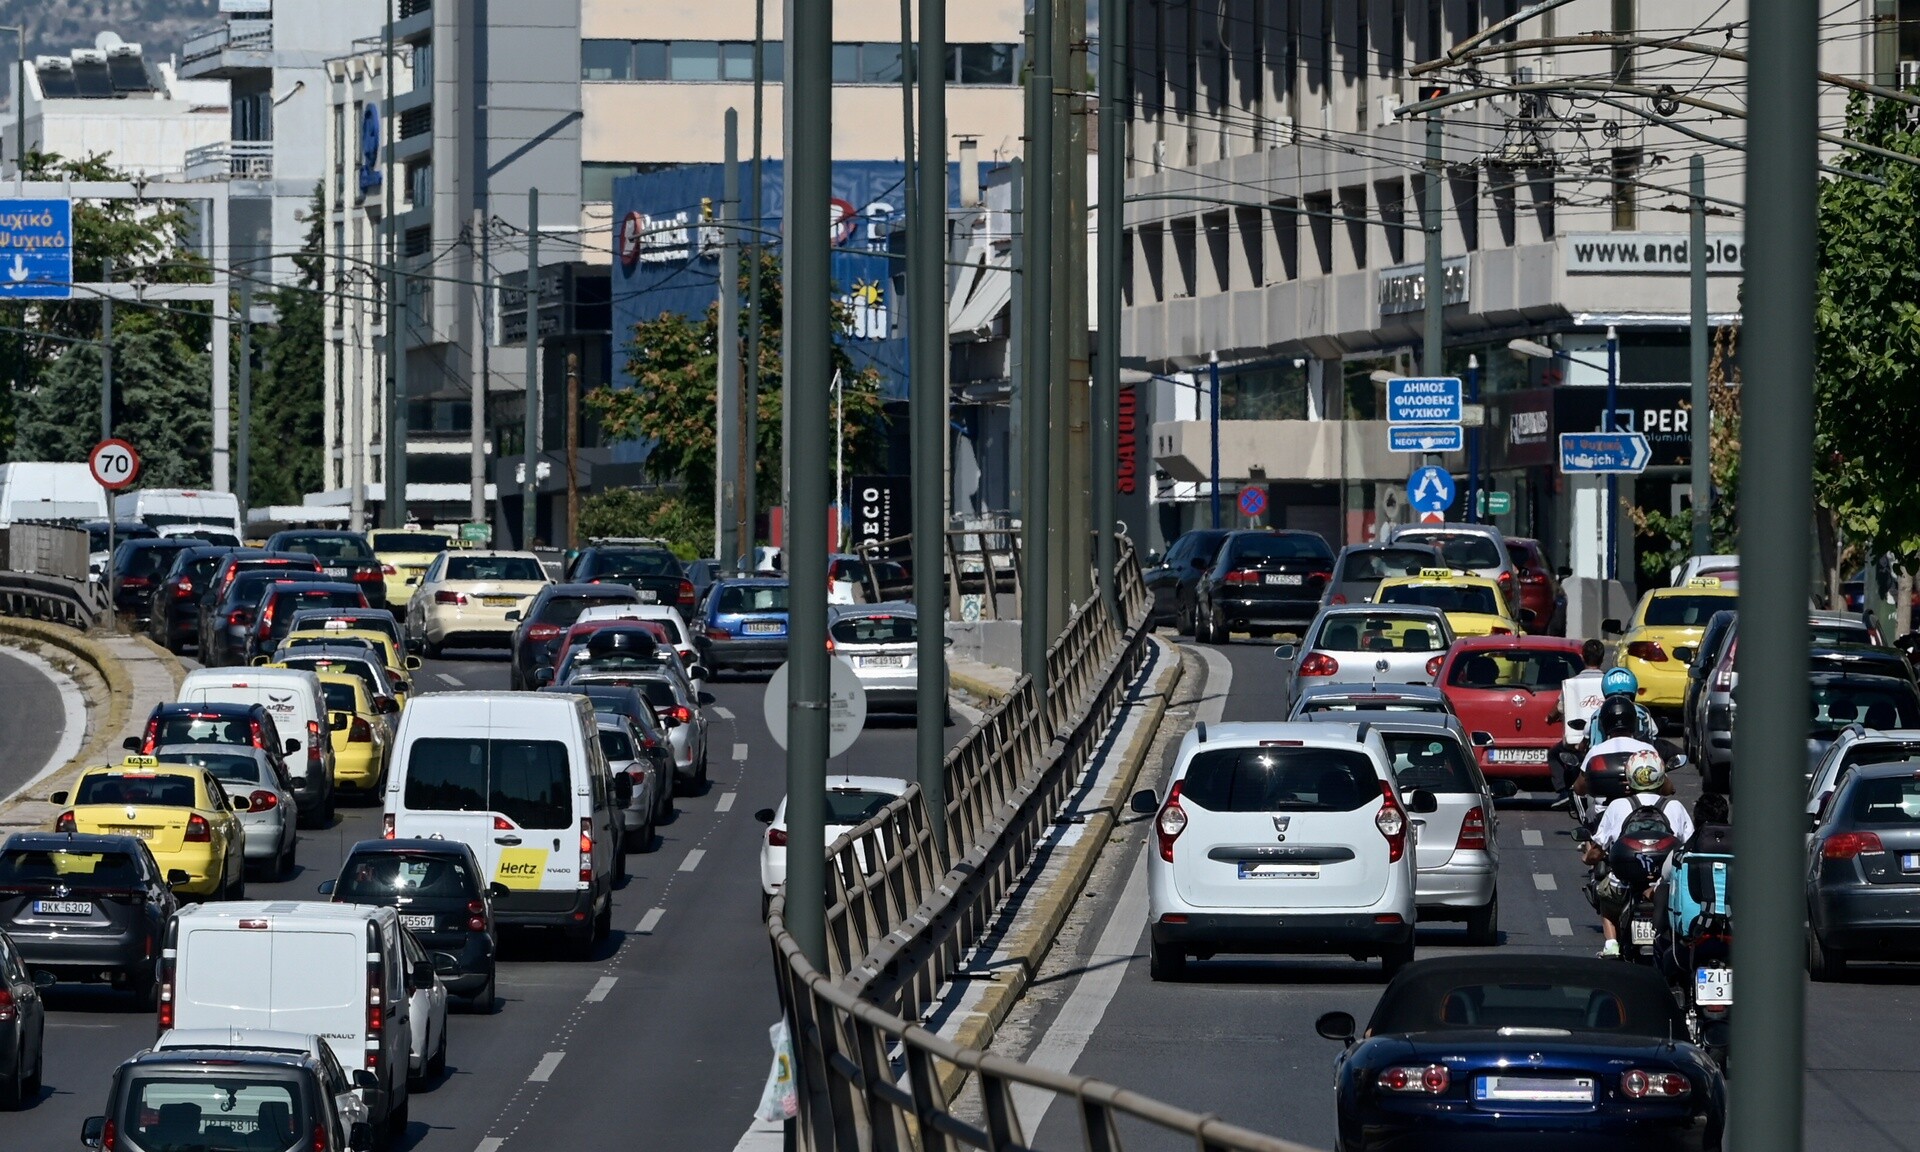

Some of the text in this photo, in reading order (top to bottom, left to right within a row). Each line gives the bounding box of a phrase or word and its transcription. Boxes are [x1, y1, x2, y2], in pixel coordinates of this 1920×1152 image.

[1403, 382, 1446, 393] ΔΗΜΟΣ
[1394, 395, 1455, 406] ΦΙΛΟΘΕΗΣ
[1399, 407, 1451, 418] ΨΥΧΙΚΟΥ
[1643, 409, 1689, 433] PER
[1395, 438, 1418, 446] ΝΕΟΥ
[101, 454, 128, 474] 70
[128, 757, 153, 765] TAXI
[1257, 847, 1306, 855] LODGY
